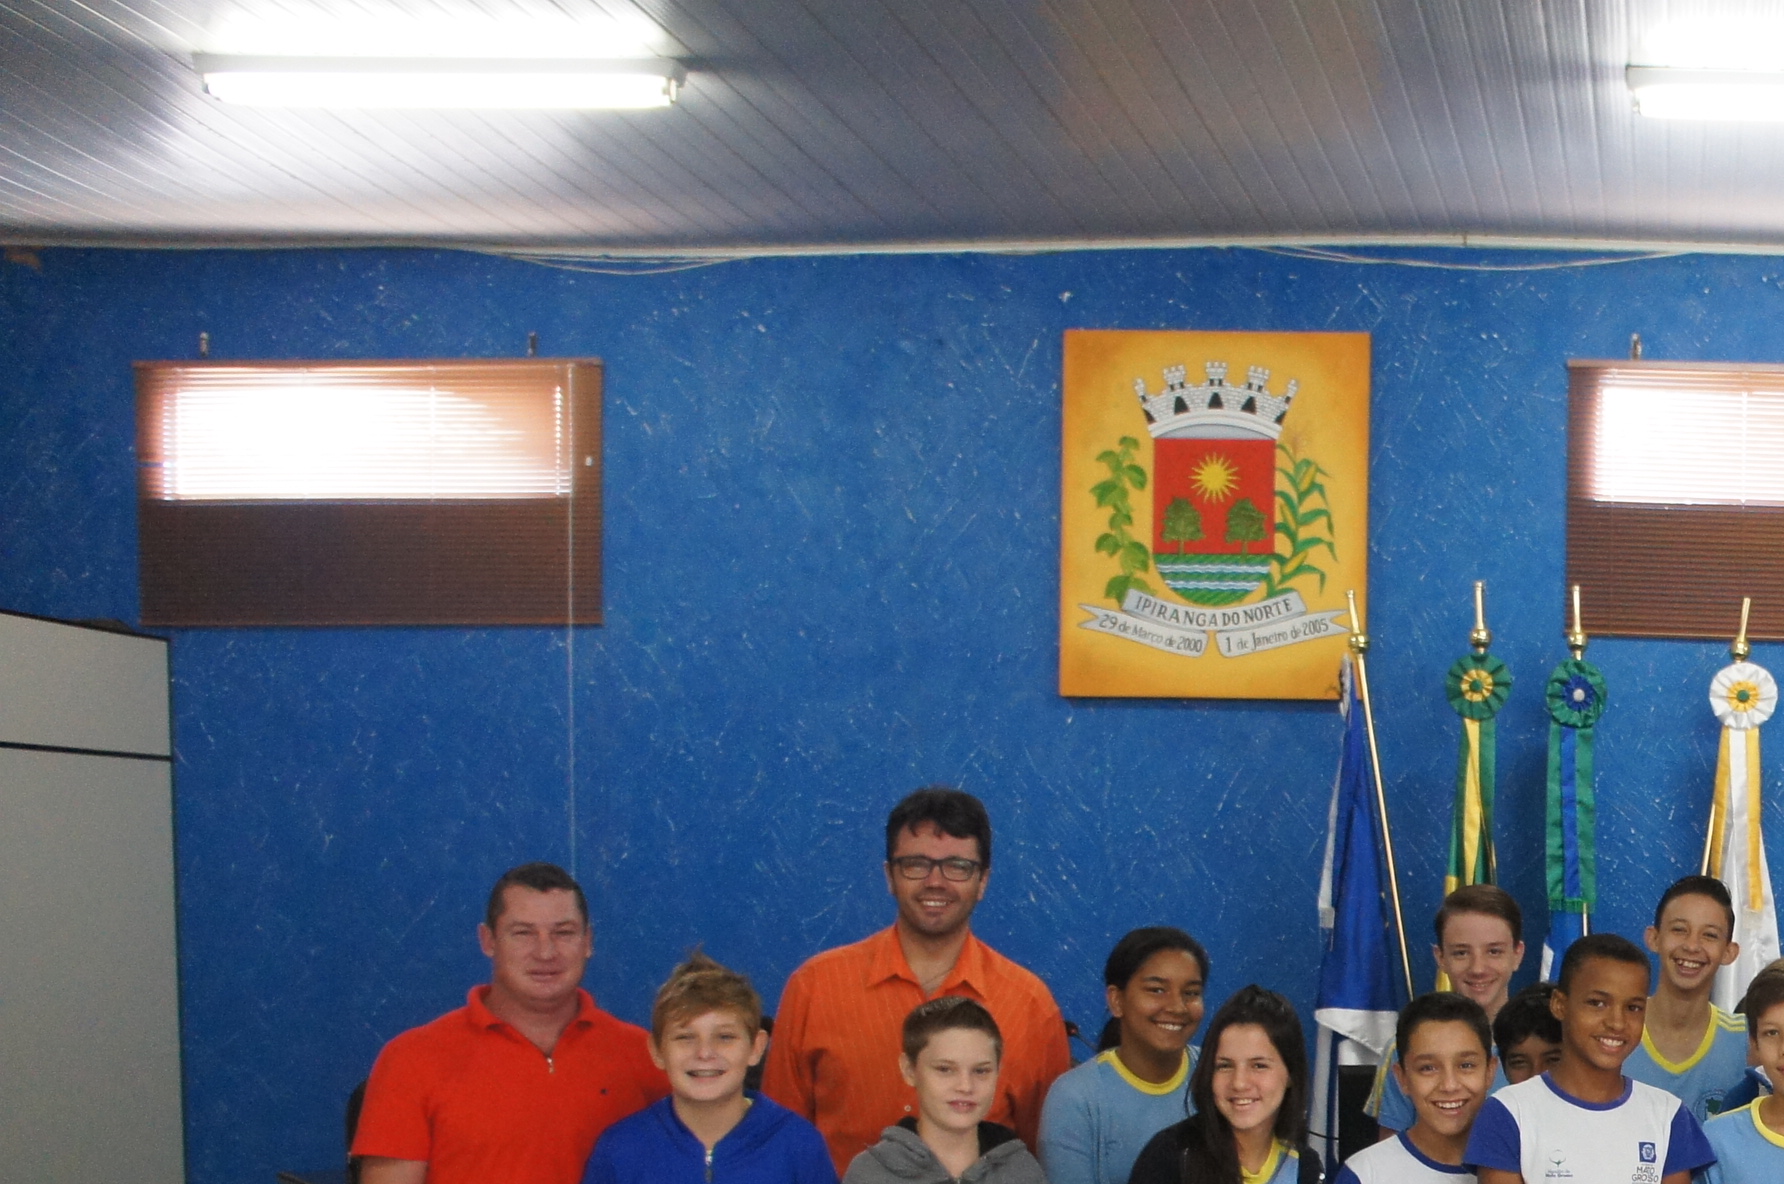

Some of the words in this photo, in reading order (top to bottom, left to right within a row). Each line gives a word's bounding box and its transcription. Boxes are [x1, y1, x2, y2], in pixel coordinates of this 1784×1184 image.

[1136, 596, 1218, 627] IPIRANGA
[1222, 611, 1241, 627] DO
[1243, 598, 1293, 624] NORTE
[1098, 613, 1118, 630] 29
[1118, 620, 1132, 635] de
[1164, 634, 1177, 648] de
[1176, 635, 1203, 653] 2000
[1225, 636, 1232, 653] 1
[1236, 637, 1249, 651] de
[1251, 630, 1289, 651] Janeiro
[1290, 625, 1302, 640] de
[1302, 618, 1329, 637] 2005
